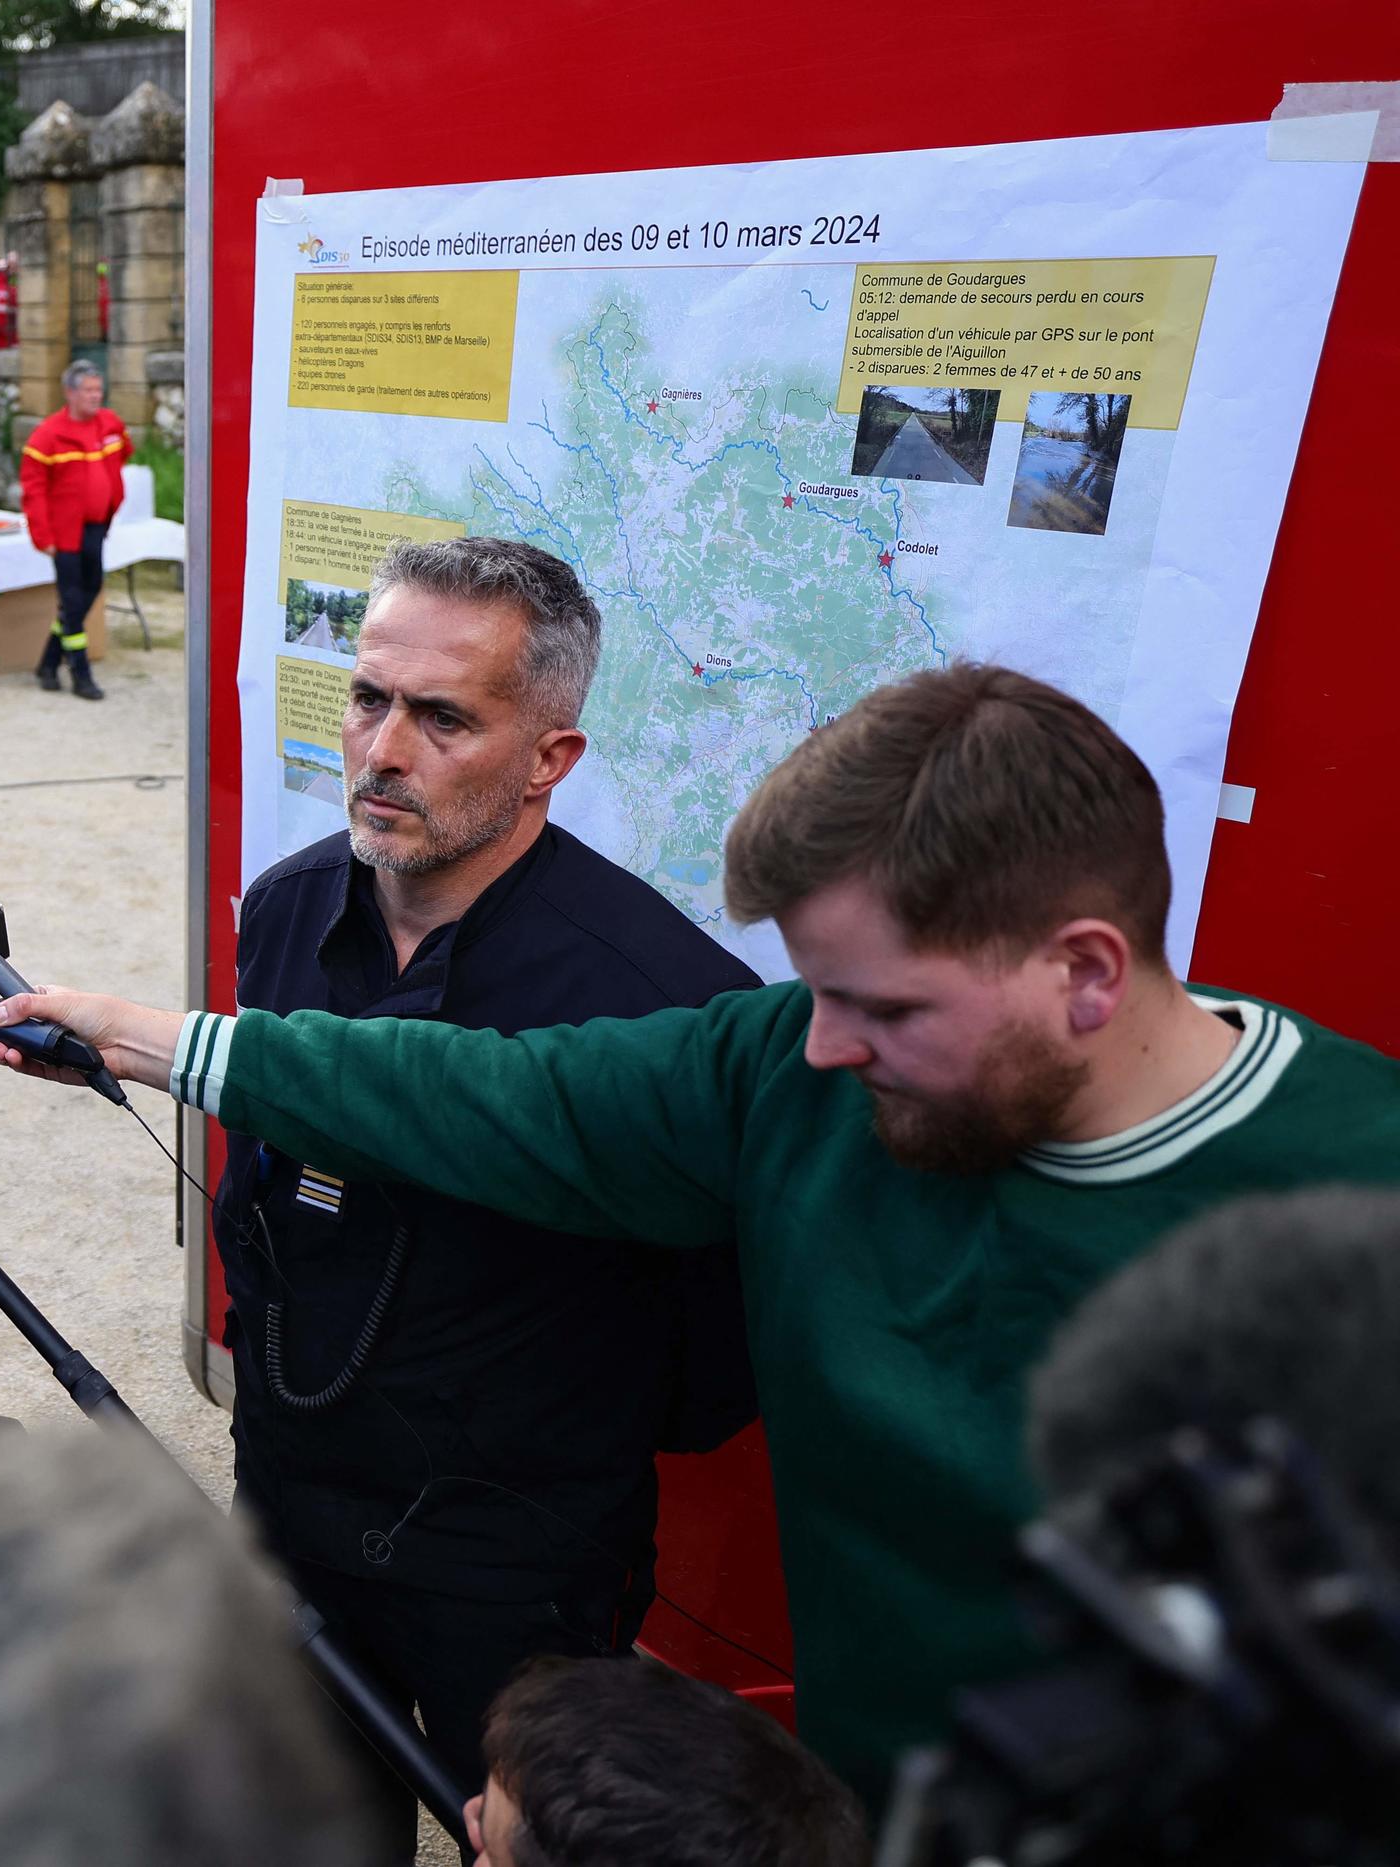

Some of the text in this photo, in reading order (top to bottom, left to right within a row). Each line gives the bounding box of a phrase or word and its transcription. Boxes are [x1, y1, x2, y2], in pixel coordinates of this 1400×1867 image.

[362, 214, 880, 262] Episode méditerranéen des 09 et 10 mars 2024
[862, 272, 1026, 288] Commune de Goudargues
[307, 296, 339, 305] personnes
[341, 294, 371, 306] disparues
[372, 296, 383, 304] sur
[384, 294, 388, 303] 3
[390, 294, 406, 304] sites
[406, 294, 440, 304] différents
[859, 290, 1144, 306] 05:12: demande de secours perdu en cours
[856, 309, 900, 324] d'appel
[301, 320, 312, 329] 120
[314, 321, 348, 330] personnels
[385, 322, 411, 332] compris
[412, 322, 422, 330] les
[424, 321, 451, 331] renforts
[426, 335, 442, 344] BMP
[444, 335, 453, 344] de
[454, 336, 490, 348] Marseille)
[854, 326, 1154, 344] Localisation d'un véhicule par GPS sur le pont
[298, 346, 378, 356] sauveteurs en eaux-vives
[852, 344, 1006, 361] submersible de l'Aiguillon
[298, 357, 364, 368] hélicoptères Dragons
[857, 361, 866, 373] 2
[868, 362, 930, 376] disparues:
[933, 363, 942, 376] 2
[945, 364, 996, 377] femmes
[1000, 366, 1016, 378] de
[1020, 366, 1038, 378] 47
[1042, 366, 1054, 378] et
[1071, 366, 1089, 380] de
[1093, 367, 1112, 380] 50
[1115, 369, 1142, 380] ans
[298, 369, 346, 380] équipes drones
[297, 381, 491, 403] 220 personnels de garde (traitement des autres opérations)
[662, 388, 702, 401] Gagnières
[799, 482, 858, 498] Goudargues
[286, 506, 362, 524] Commune de Gagnières
[308, 520, 314, 528] la
[316, 522, 328, 531] voie
[330, 525, 340, 533] est
[340, 526, 362, 536] fermée
[368, 530, 374, 538] la
[307, 532, 316, 540] un
[318, 534, 342, 546] véhicule
[344, 537, 372, 552] s'engage
[372, 544, 386, 552] ave
[898, 540, 938, 556] Codolet
[295, 544, 326, 554] personne
[327, 548, 352, 559] parvient
[328, 560, 350, 570] homme
[352, 563, 360, 572] de
[706, 654, 732, 666] Dions
[280, 662, 342, 682] Commune de Dions
[291, 688, 318, 699] emporté
[320, 695, 334, 703] avec
[340, 699, 348, 707] pe
[338, 688, 350, 698] eng
[280, 696, 288, 704] Le
[290, 697, 306, 708] débit
[317, 703, 338, 715] Gardon
[284, 718, 288, 726] 3
[290, 708, 312, 720] femme
[322, 716, 330, 724] 40
